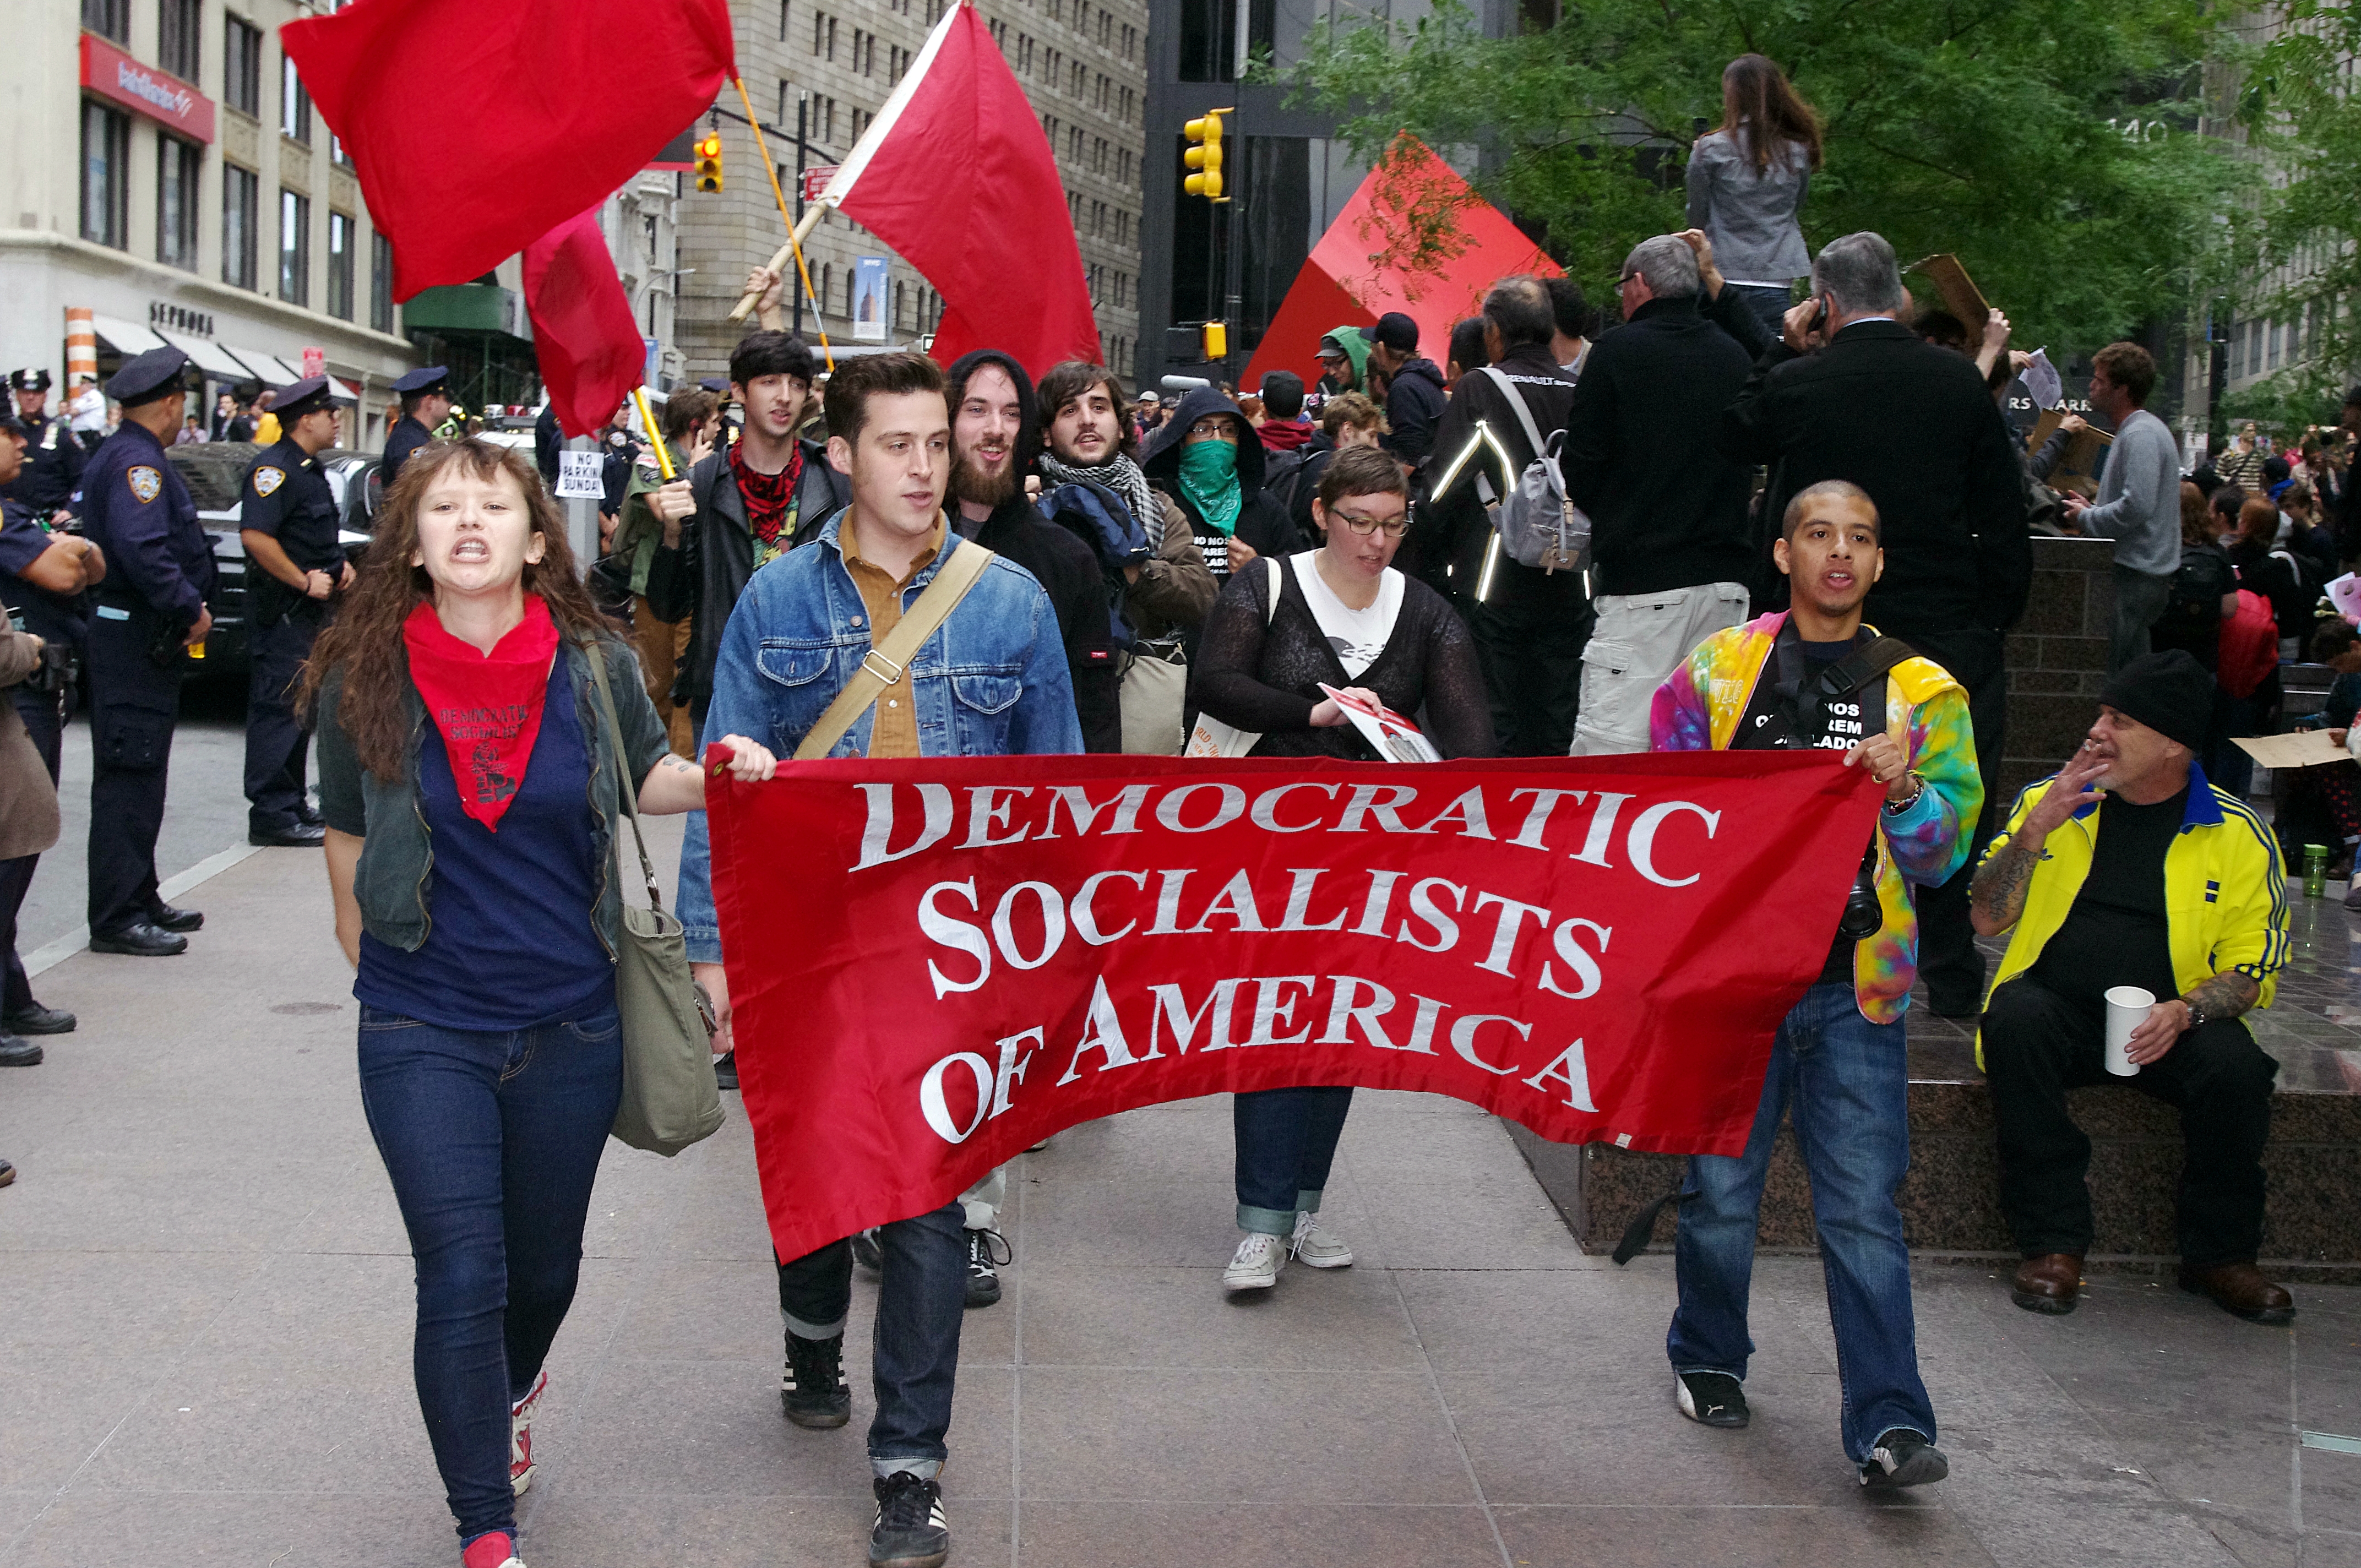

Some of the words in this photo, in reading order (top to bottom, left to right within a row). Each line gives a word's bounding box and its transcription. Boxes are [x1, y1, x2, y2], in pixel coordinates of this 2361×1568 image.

[578, 453, 592, 465] NO
[848, 783, 1722, 888] DEMOCRATIC
[917, 868, 1612, 1000] SOCIALISTS
[920, 1025, 1044, 1144] OF
[1057, 974, 1599, 1113] AMERICA
